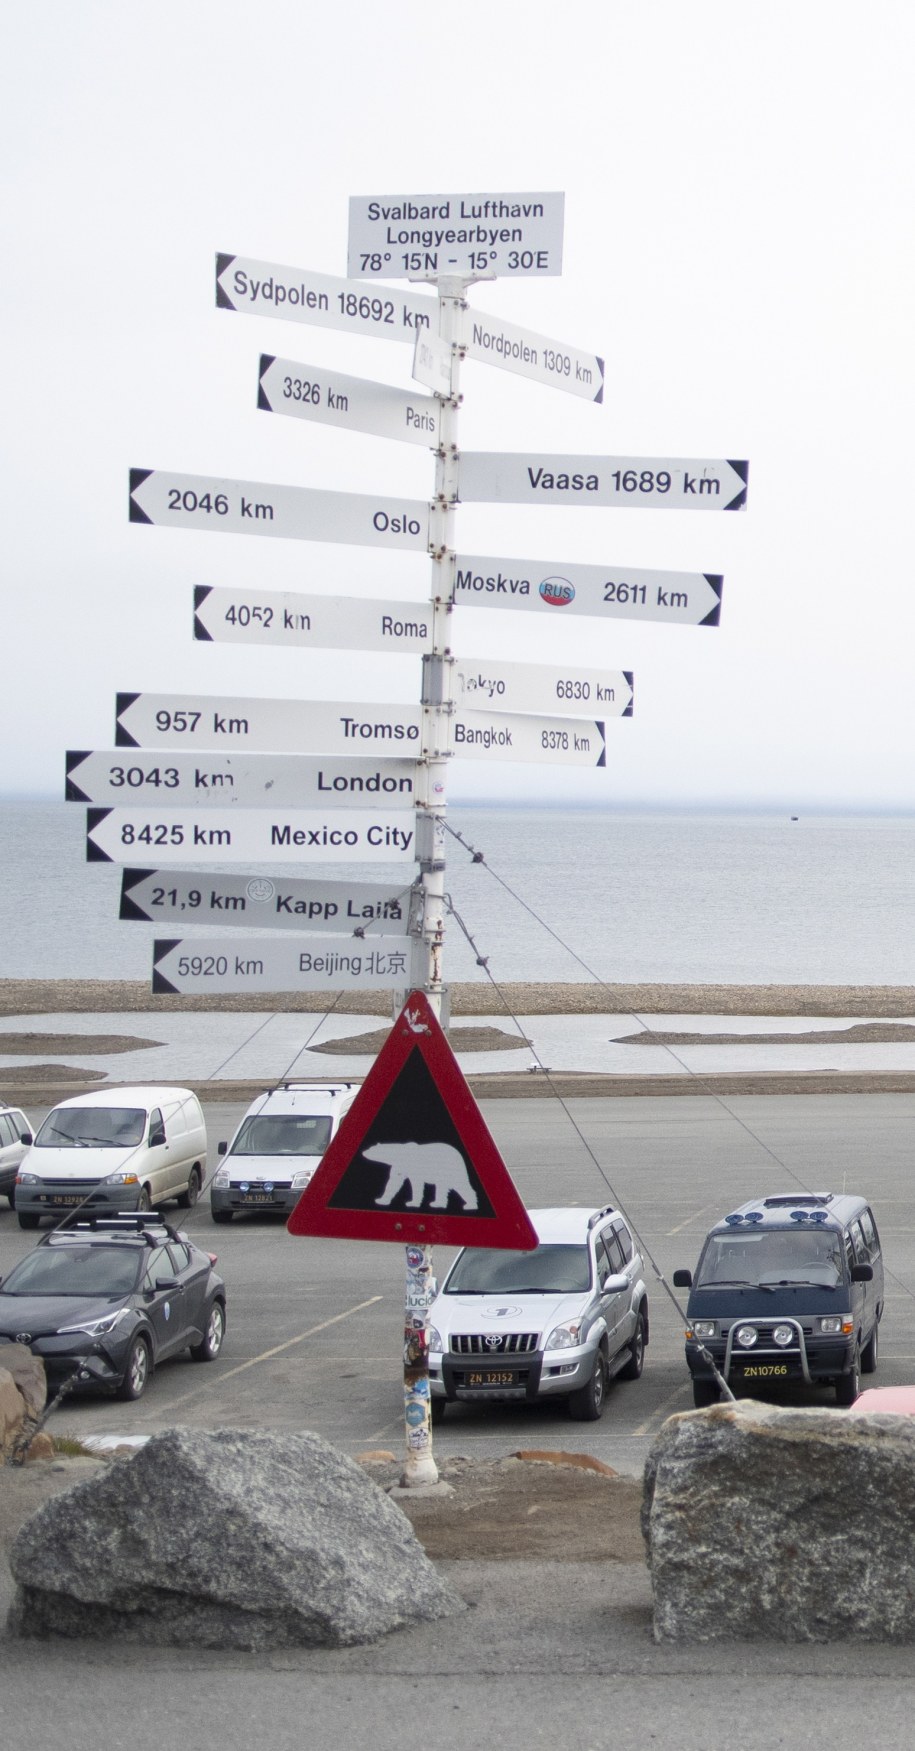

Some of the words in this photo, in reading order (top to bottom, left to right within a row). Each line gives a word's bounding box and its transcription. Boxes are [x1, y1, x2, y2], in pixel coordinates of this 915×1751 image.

[367, 201, 450, 221] Svalbard
[460, 200, 544, 219] Lufthavn
[386, 225, 523, 247] Longyearbyen
[359, 253, 392, 271] 78°
[467, 251, 498, 270] 15°
[233, 270, 329, 311] Sydpolen
[337, 292, 395, 324] 18692
[402, 304, 430, 329] km
[472, 323, 538, 365] Nordpolen
[542, 348, 571, 377] 1309
[575, 360, 593, 385] km
[283, 376, 321, 405] 3326
[327, 387, 349, 412] km
[405, 406, 436, 432] Paris
[527, 467, 600, 491] Vaasa
[611, 469, 672, 494] 1689
[683, 472, 721, 494] km
[167, 488, 229, 516] 2046
[240, 496, 274, 520] km
[372, 511, 421, 535] Oslo
[456, 569, 531, 595] Moskva
[543, 582, 571, 599] RUS
[603, 581, 647, 605] 2611
[656, 586, 689, 608] km
[283, 608, 311, 630] km
[382, 615, 428, 638] Roma
[556, 679, 591, 700] 6830
[596, 682, 615, 702] km
[155, 710, 202, 732] 957
[213, 712, 249, 734] km
[339, 717, 420, 740] Tromsø
[454, 723, 513, 749] Bangkok
[541, 730, 569, 750] 8378
[574, 733, 590, 751] km
[108, 766, 180, 788] 3043
[194, 768, 234, 788] km
[317, 771, 413, 793] London
[121, 823, 185, 846] 8425
[193, 824, 232, 845] km
[271, 825, 359, 846] Mexico
[366, 825, 414, 851] City
[151, 887, 202, 910] 21,9
[210, 891, 246, 911] km
[275, 895, 339, 920] Kapp
[177, 956, 228, 977] 5920
[234, 956, 264, 975] km
[469, 1373, 482, 1383] ZN
[486, 1372, 513, 1382] 12152
